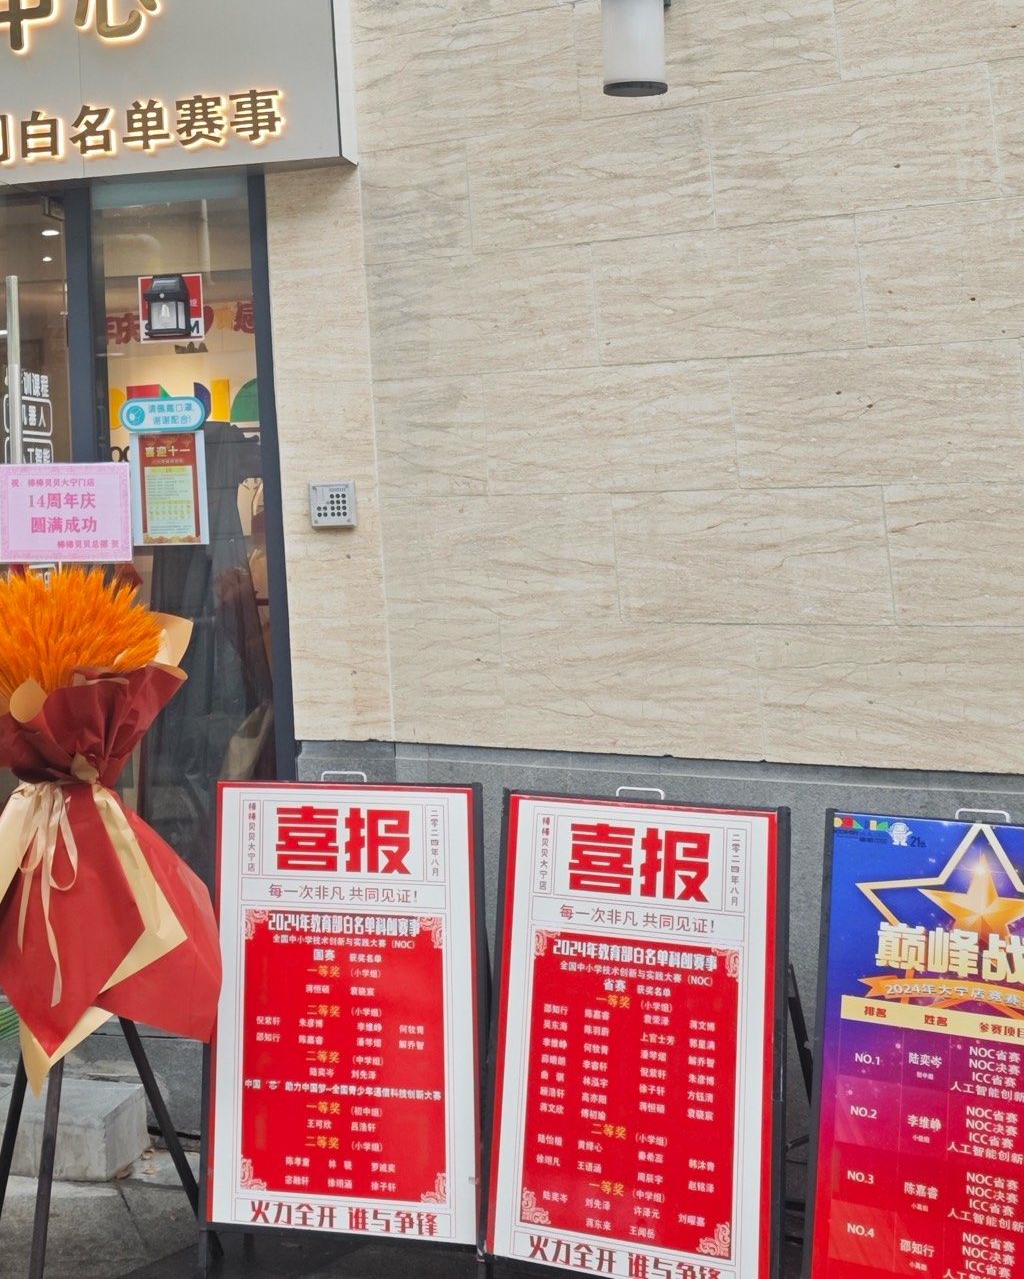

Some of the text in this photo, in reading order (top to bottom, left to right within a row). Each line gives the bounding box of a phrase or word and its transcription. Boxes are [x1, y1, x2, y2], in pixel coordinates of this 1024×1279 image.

[145, 445, 190, 458] 喜迎十一
[28, 478, 95, 488] 棒棒贝贝大宁门店
[28, 492, 96, 510] 14周年庆
[31, 516, 97, 534] 圆满成功
[247, 802, 257, 872] 棒棒贝贝大宁店
[276, 805, 412, 875] 喜报
[430, 809, 440, 877] 二零二四年八月
[539, 817, 551, 891] 棒棒贝贝大宁店
[568, 823, 711, 903] 喜报
[730, 833, 741, 907] 二零二四年八月
[269, 883, 345, 901] 每一次非凡
[560, 905, 638, 926] 每一次非凡
[268, 913, 420, 938] 2024年教育部白名单科创赛事
[313, 948, 382, 963] 国赛 获奖名单
[553, 939, 718, 972] 2024年教育部白名单科创赛事
[307, 966, 340, 978] 一等奖
[604, 979, 672, 997] 省赛 获奖名单
[307, 1004, 340, 1017] 二等奖
[596, 995, 630, 1009] 一等奖
[864, 1005, 887, 1018] 排名
[924, 1014, 948, 1027] 姓名
[306, 1050, 340, 1063] 二等奖
[854, 1052, 881, 1065] NO.1
[969, 1046, 1021, 1063] NOC省赛
[968, 1058, 1021, 1075] NOC决赛
[972, 1071, 1017, 1088] ICC省赛
[306, 1102, 340, 1115] 一等奖
[850, 1105, 877, 1119] NO.2
[966, 1106, 1019, 1123] NOC省赛
[591, 1123, 626, 1139] 二等奖
[965, 1119, 1018, 1136] NOC决赛
[305, 1136, 339, 1149] 二等奖
[969, 1132, 1014, 1149] ICC省赛
[847, 1170, 874, 1184] NO.3
[966, 1172, 1019, 1190] NOC省赛
[589, 1183, 624, 1197] 一等奖
[966, 1185, 1019, 1204] NOC决赛
[969, 1199, 1015, 1217] ICC省赛
[251, 1200, 437, 1236] 火力全开 谁与争锋
[847, 1223, 875, 1238] NO.4
[962, 1232, 1015, 1251] NOC省赛
[529, 1236, 616, 1273] 火力全开
[962, 1246, 1015, 1264] NOC决赛
[965, 1260, 1011, 1278] ICC省赛
